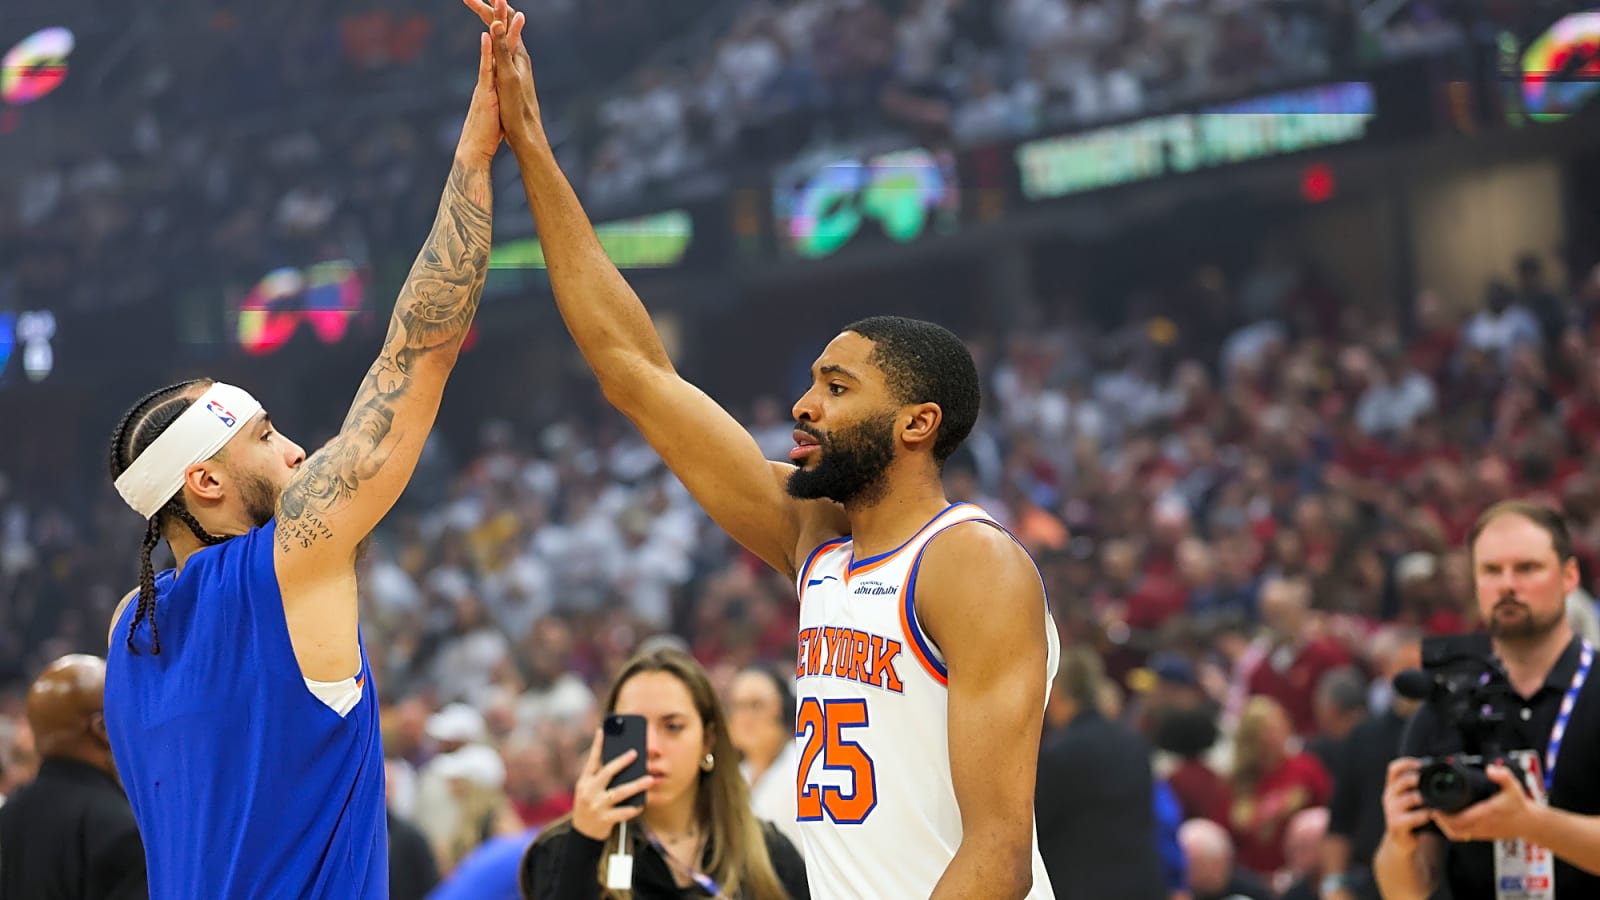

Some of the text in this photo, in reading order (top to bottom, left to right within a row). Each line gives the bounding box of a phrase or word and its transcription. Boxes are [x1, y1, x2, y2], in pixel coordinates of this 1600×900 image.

[304, 510, 333, 539] HAVE
[796, 626, 904, 694] EW YORK
[796, 697, 877, 824] 25
